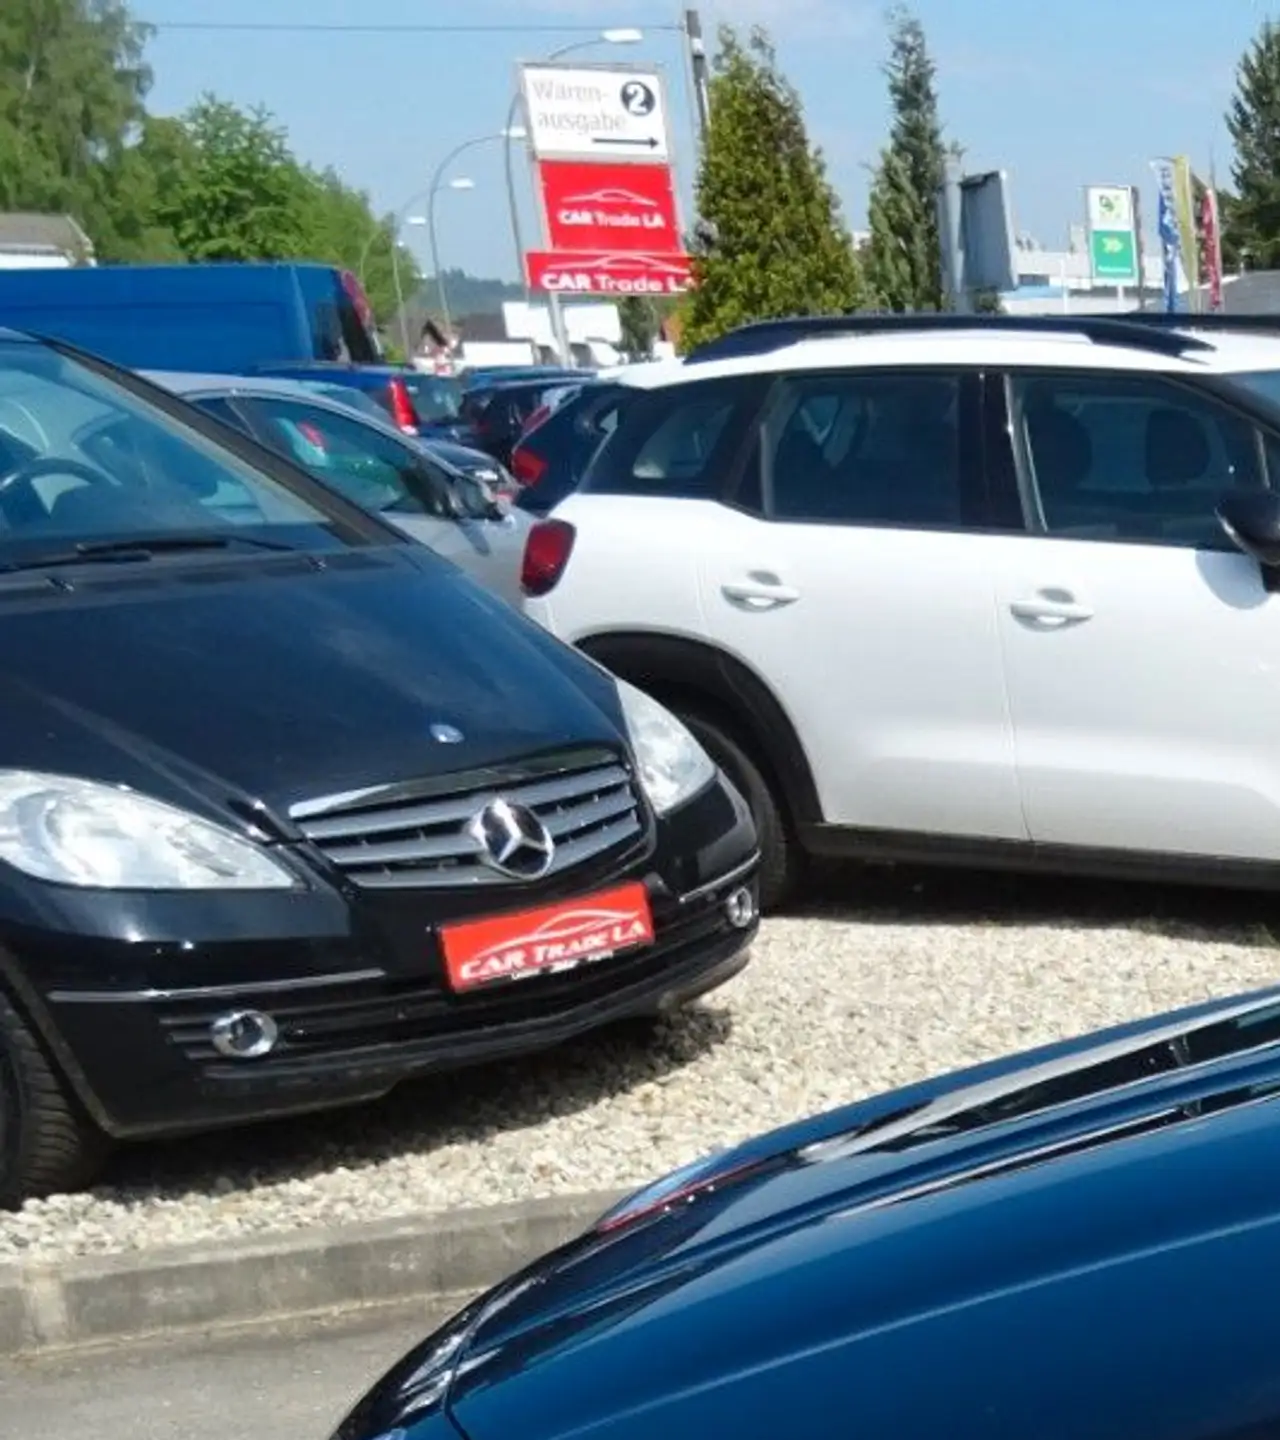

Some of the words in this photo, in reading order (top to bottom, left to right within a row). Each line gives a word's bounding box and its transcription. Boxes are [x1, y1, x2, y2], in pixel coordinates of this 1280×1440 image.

[559, 210, 594, 225] CAR
[595, 211, 641, 228] Trade
[643, 212, 665, 228] LA
[540, 272, 592, 290] CAR
[594, 274, 664, 292] Trade
[459, 952, 527, 980] CAR
[611, 919, 646, 941] LA
